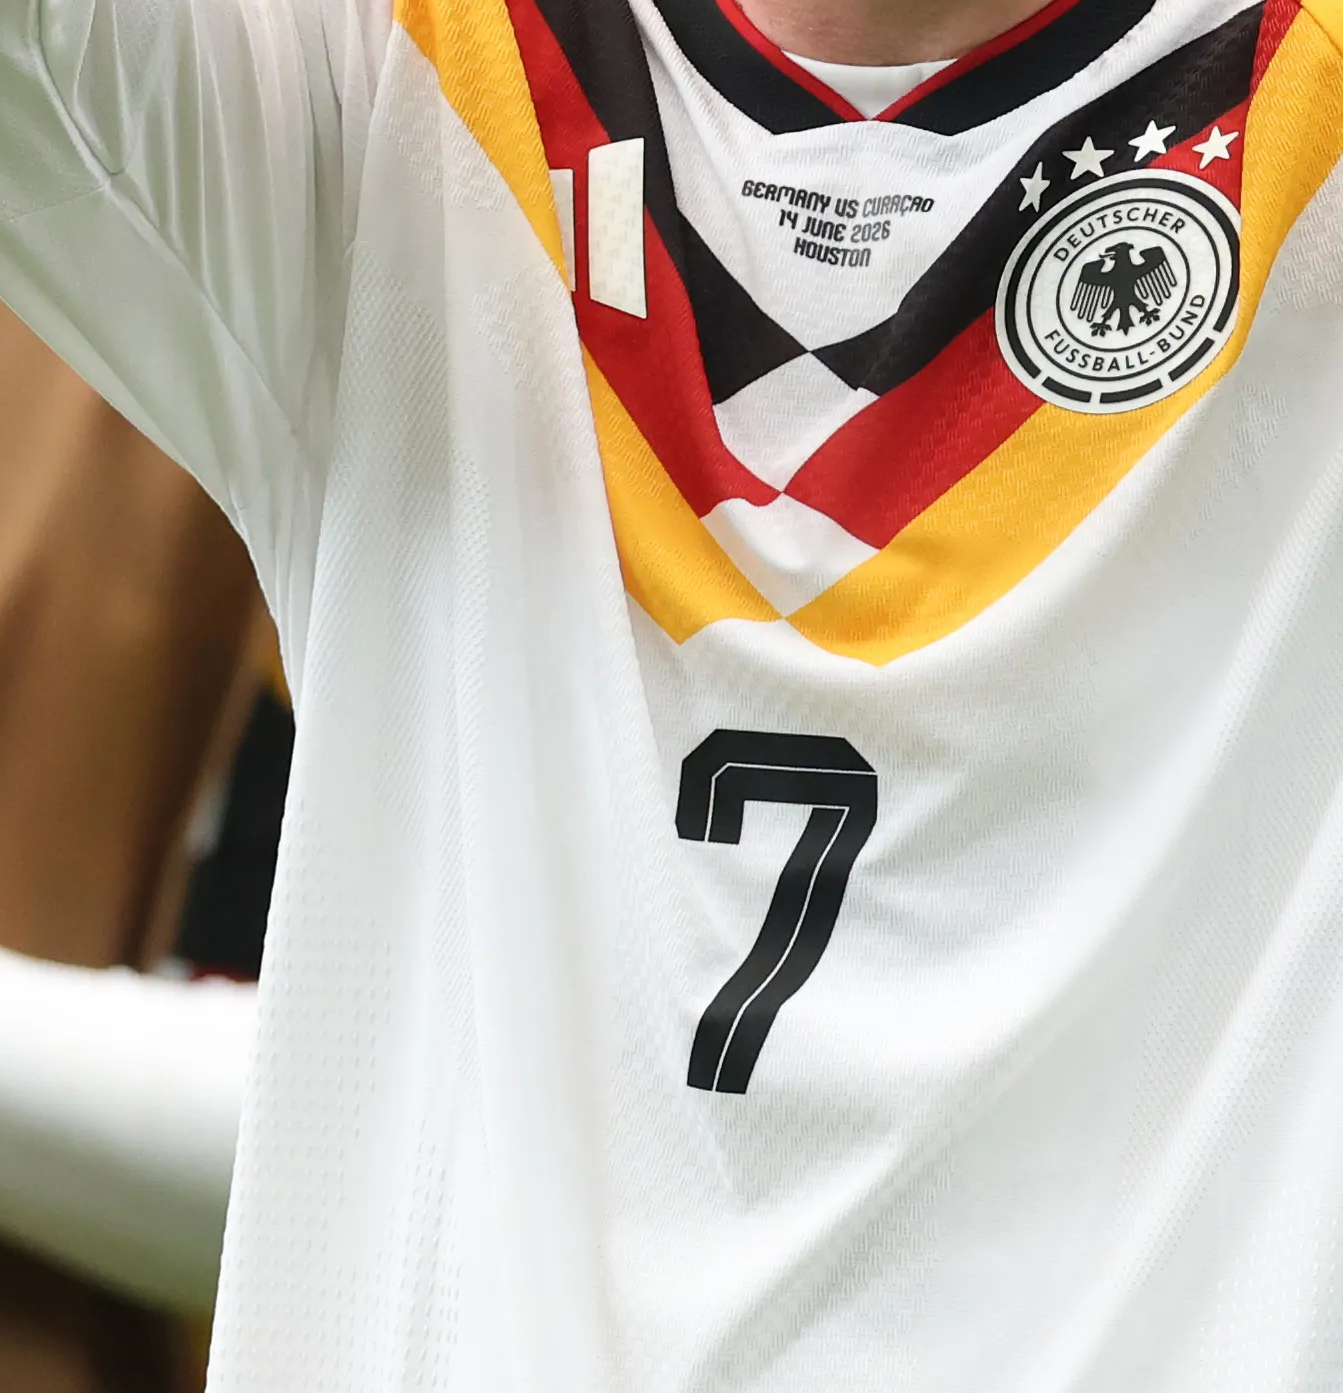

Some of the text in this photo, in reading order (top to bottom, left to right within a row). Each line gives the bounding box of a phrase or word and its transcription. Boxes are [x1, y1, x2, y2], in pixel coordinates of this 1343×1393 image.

[741, 180, 831, 214] GERMANY
[862, 194, 935, 218] CURAÇAO
[778, 209, 891, 243] 14 JUNE 2026
[1053, 207, 1185, 262] DEUTSCHER
[793, 237, 871, 267] HOUSTON
[1044, 294, 1205, 372] FUSSBALL-BUND
[675, 728, 878, 1095] 7
